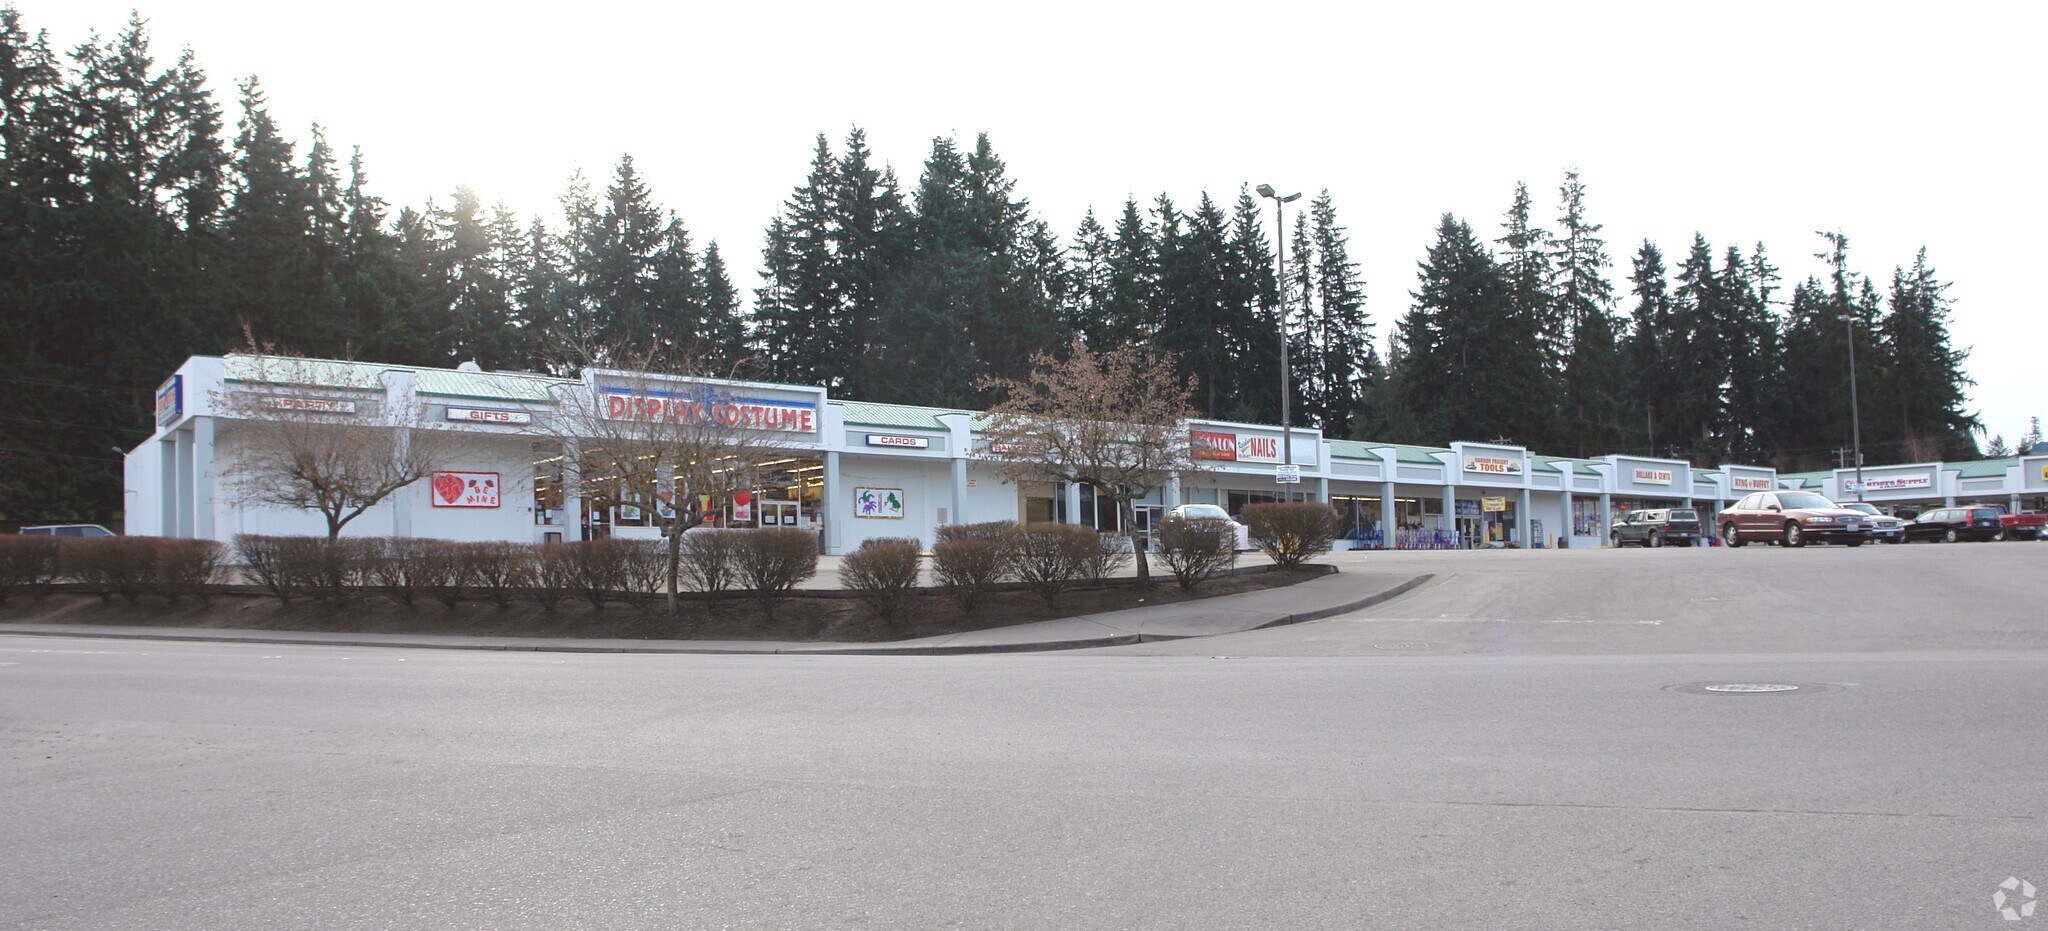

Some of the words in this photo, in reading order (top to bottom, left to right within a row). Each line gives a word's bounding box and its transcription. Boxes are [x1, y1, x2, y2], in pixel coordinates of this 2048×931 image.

[282, 399, 335, 409] PARTY
[469, 411, 509, 421] GIFTS
[608, 396, 703, 425] DISPLAY
[712, 403, 813, 431] COSTUME
[881, 436, 917, 446] CARDS
[1206, 436, 1235, 452] SALON
[1250, 437, 1277, 459] NAILS
[1480, 463, 1504, 473] TOOLS
[1636, 470, 1653, 480] DOLLARS
[1658, 472, 1671, 481] CENTS
[1734, 478, 1749, 488] KING
[1752, 480, 1770, 489] BUFFET
[1897, 478, 1928, 486] SUPPLY
[474, 486, 489, 495] BE
[466, 495, 496, 505] MINE
